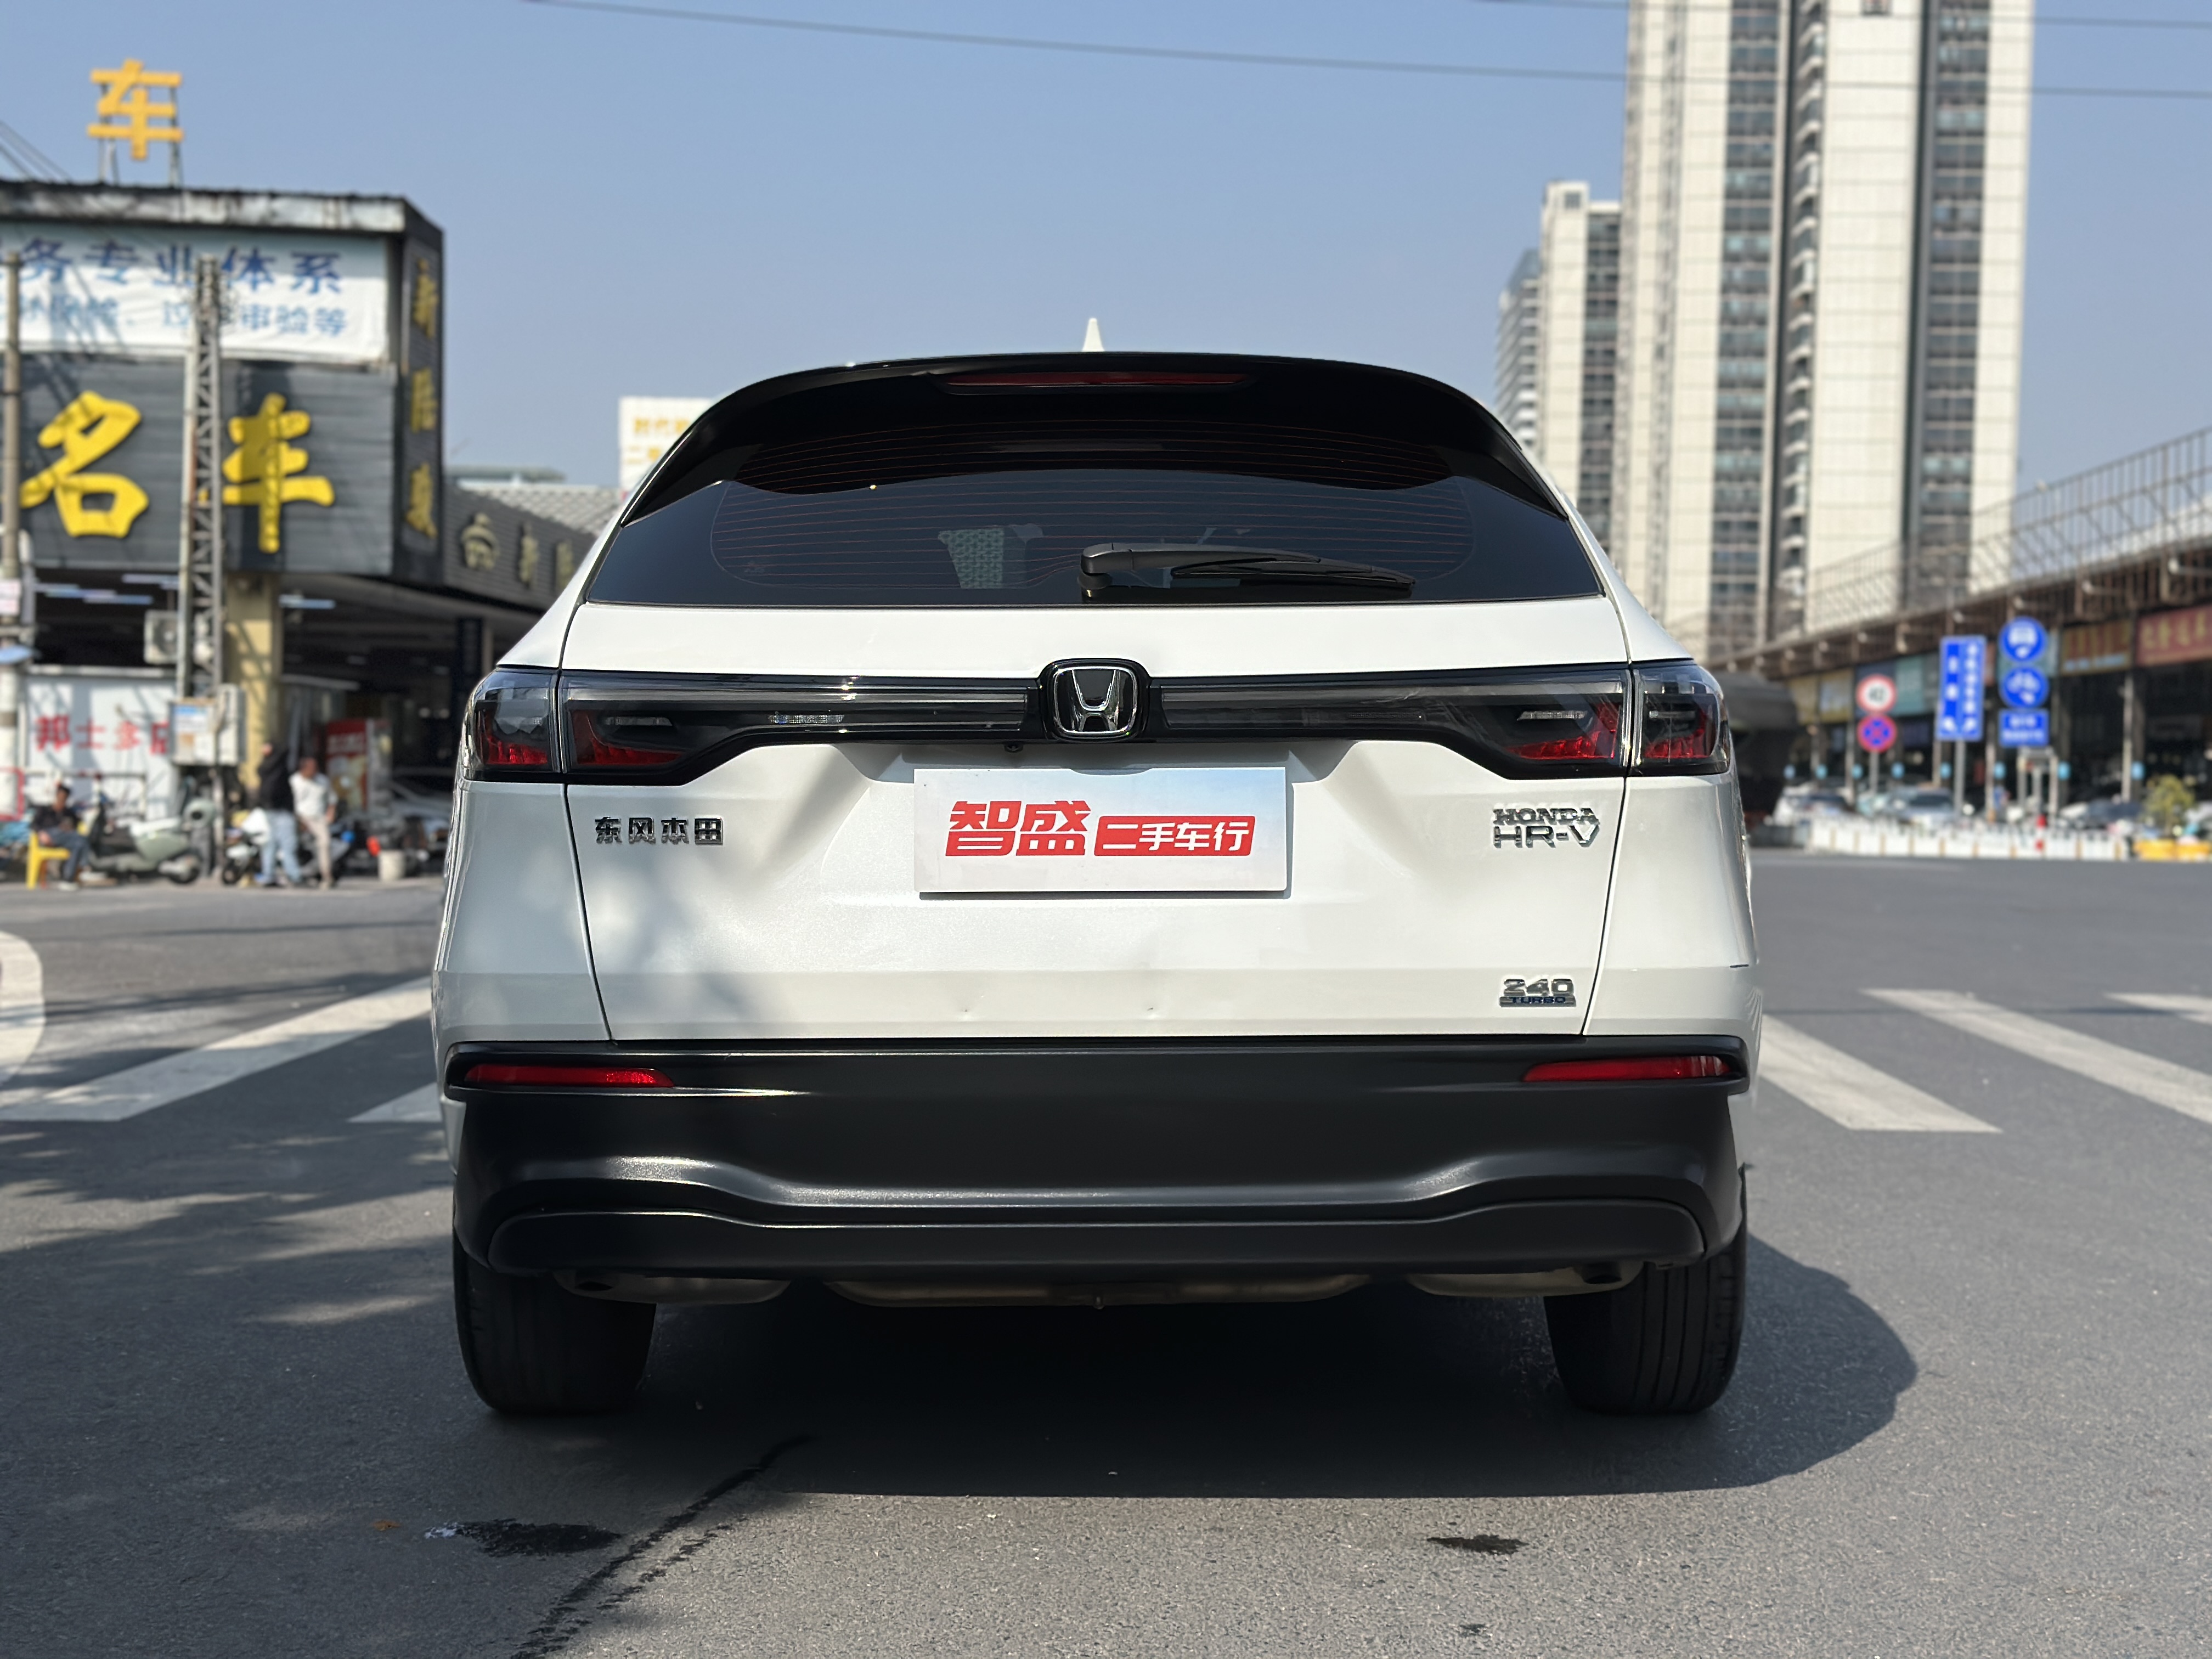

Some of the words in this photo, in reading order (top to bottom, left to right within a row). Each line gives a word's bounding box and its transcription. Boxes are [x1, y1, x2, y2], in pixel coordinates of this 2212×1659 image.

[87, 59, 183, 160] 车
[0, 237, 343, 295] 务专业体系
[595, 816, 724, 846] 东风本田
[945, 800, 1092, 856] 智盛
[1102, 822, 1250, 851] 二手车行
[1493, 808, 1600, 825] HONDA
[1493, 823, 1600, 849] HR-V
[1503, 978, 1575, 997] 240
